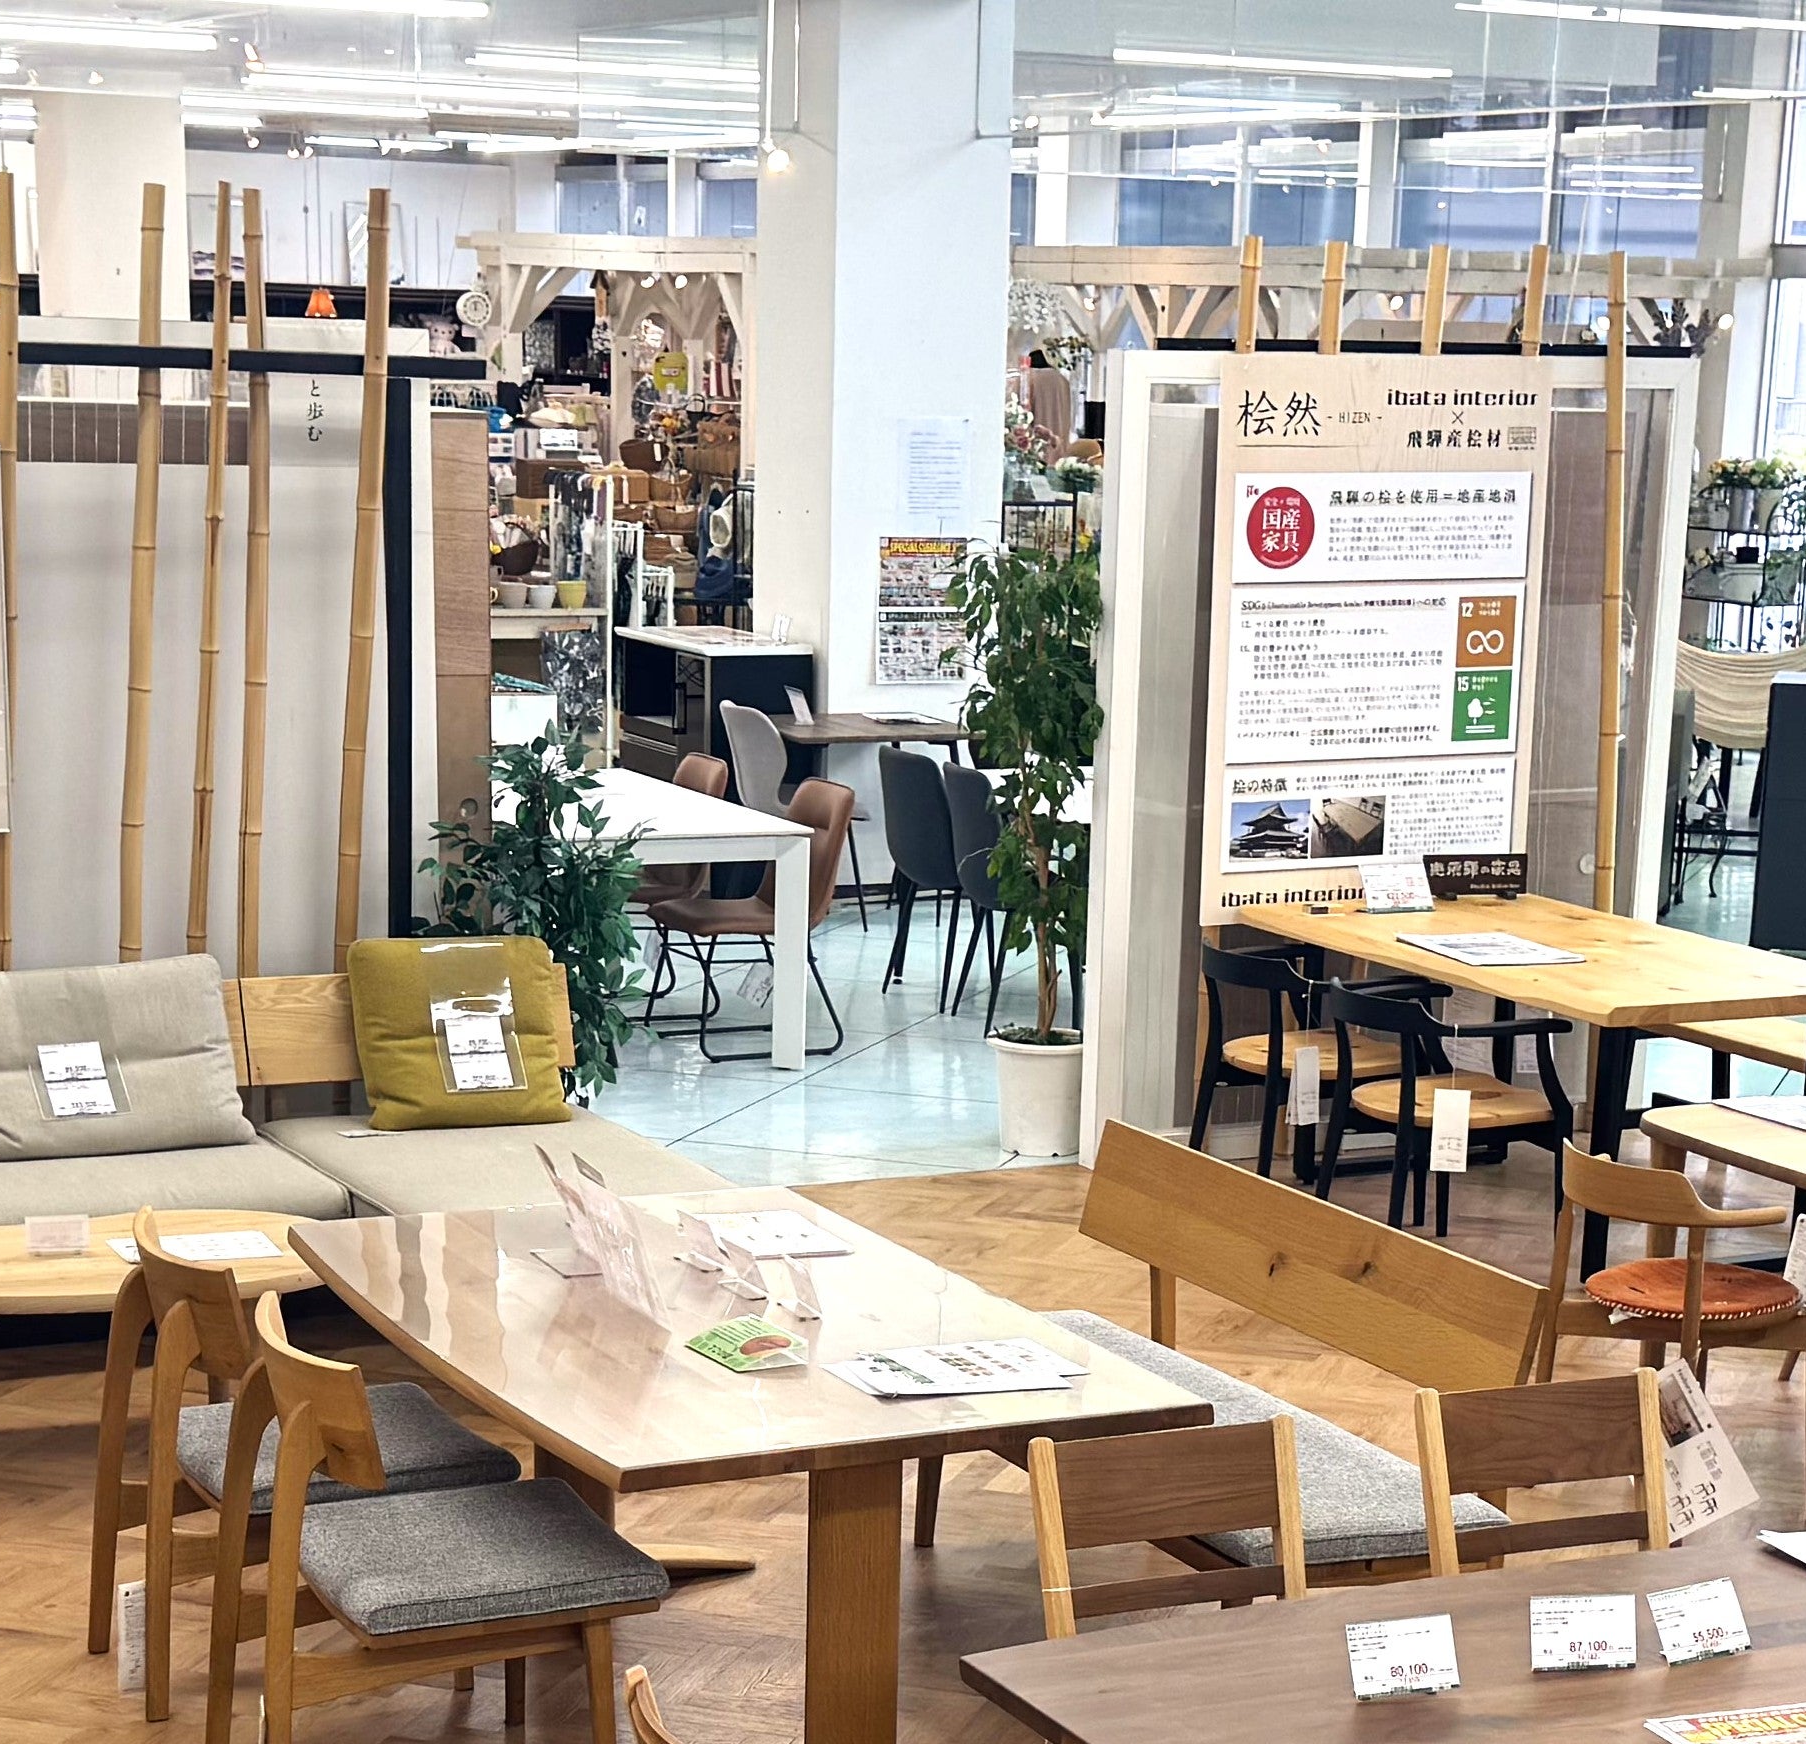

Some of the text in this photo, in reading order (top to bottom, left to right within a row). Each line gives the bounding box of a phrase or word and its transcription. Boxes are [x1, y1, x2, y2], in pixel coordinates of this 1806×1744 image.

[1387, 388, 1539, 406] ibata interior
[307, 379, 324, 442] と歩む
[1237, 390, 1322, 437] 桧然
[1261, 530, 1300, 552] 家具
[1457, 676, 1469, 693] 15
[1222, 889, 1278, 907] ibata
